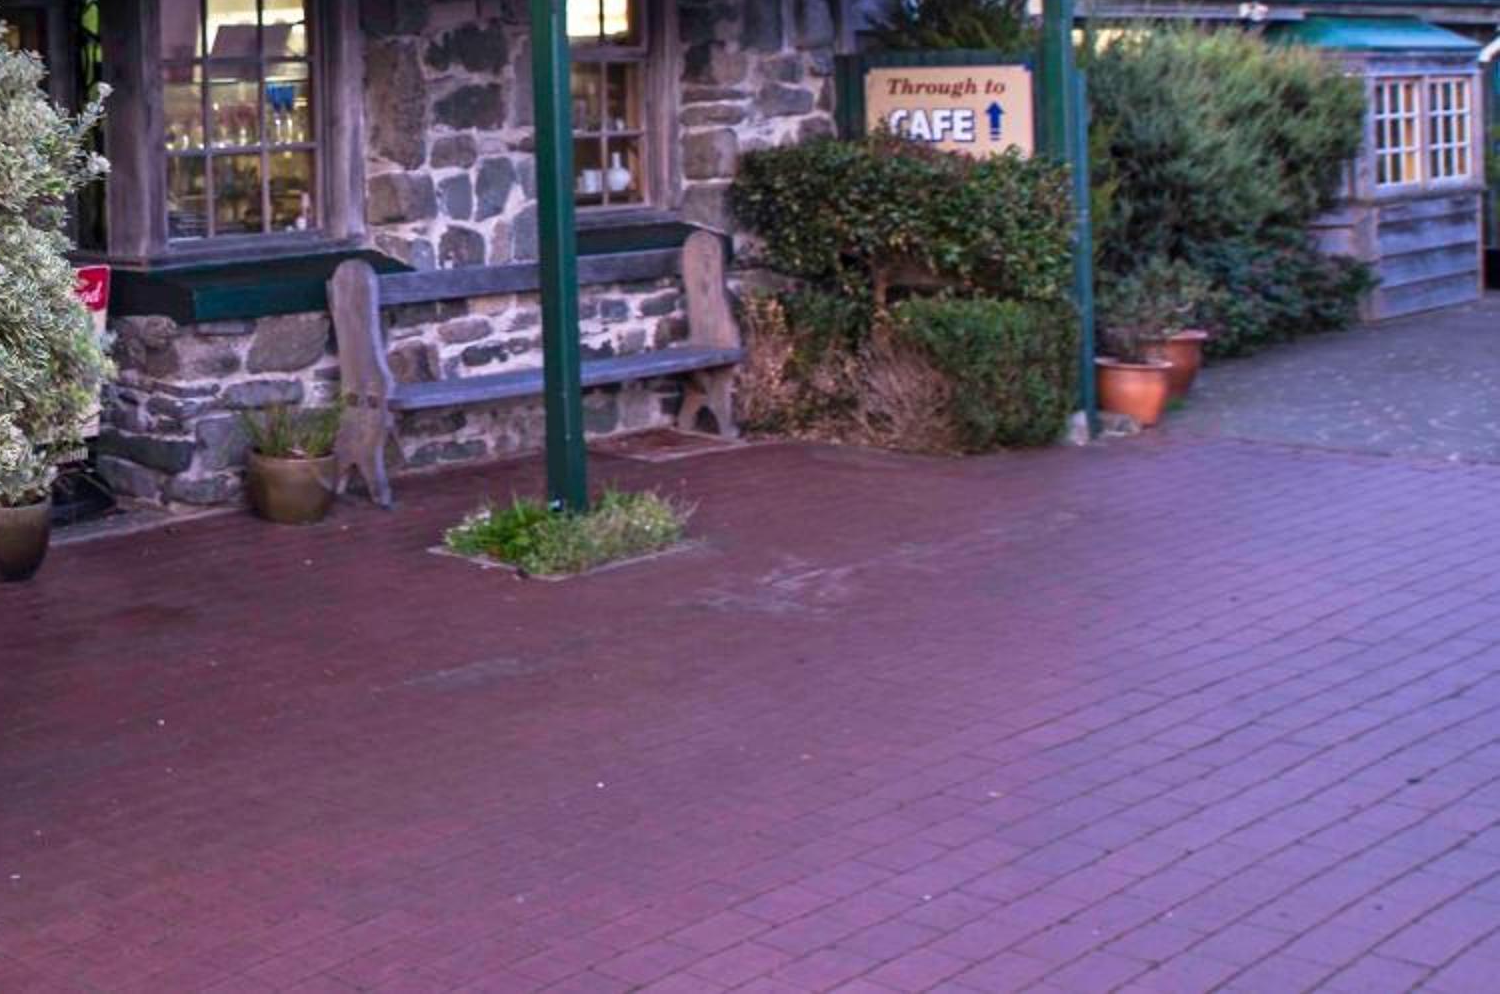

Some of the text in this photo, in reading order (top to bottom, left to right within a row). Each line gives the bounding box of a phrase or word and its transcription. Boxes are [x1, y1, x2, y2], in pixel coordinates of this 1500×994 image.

[887, 78, 1006, 98] Through to
[889, 108, 975, 142] CAFE
